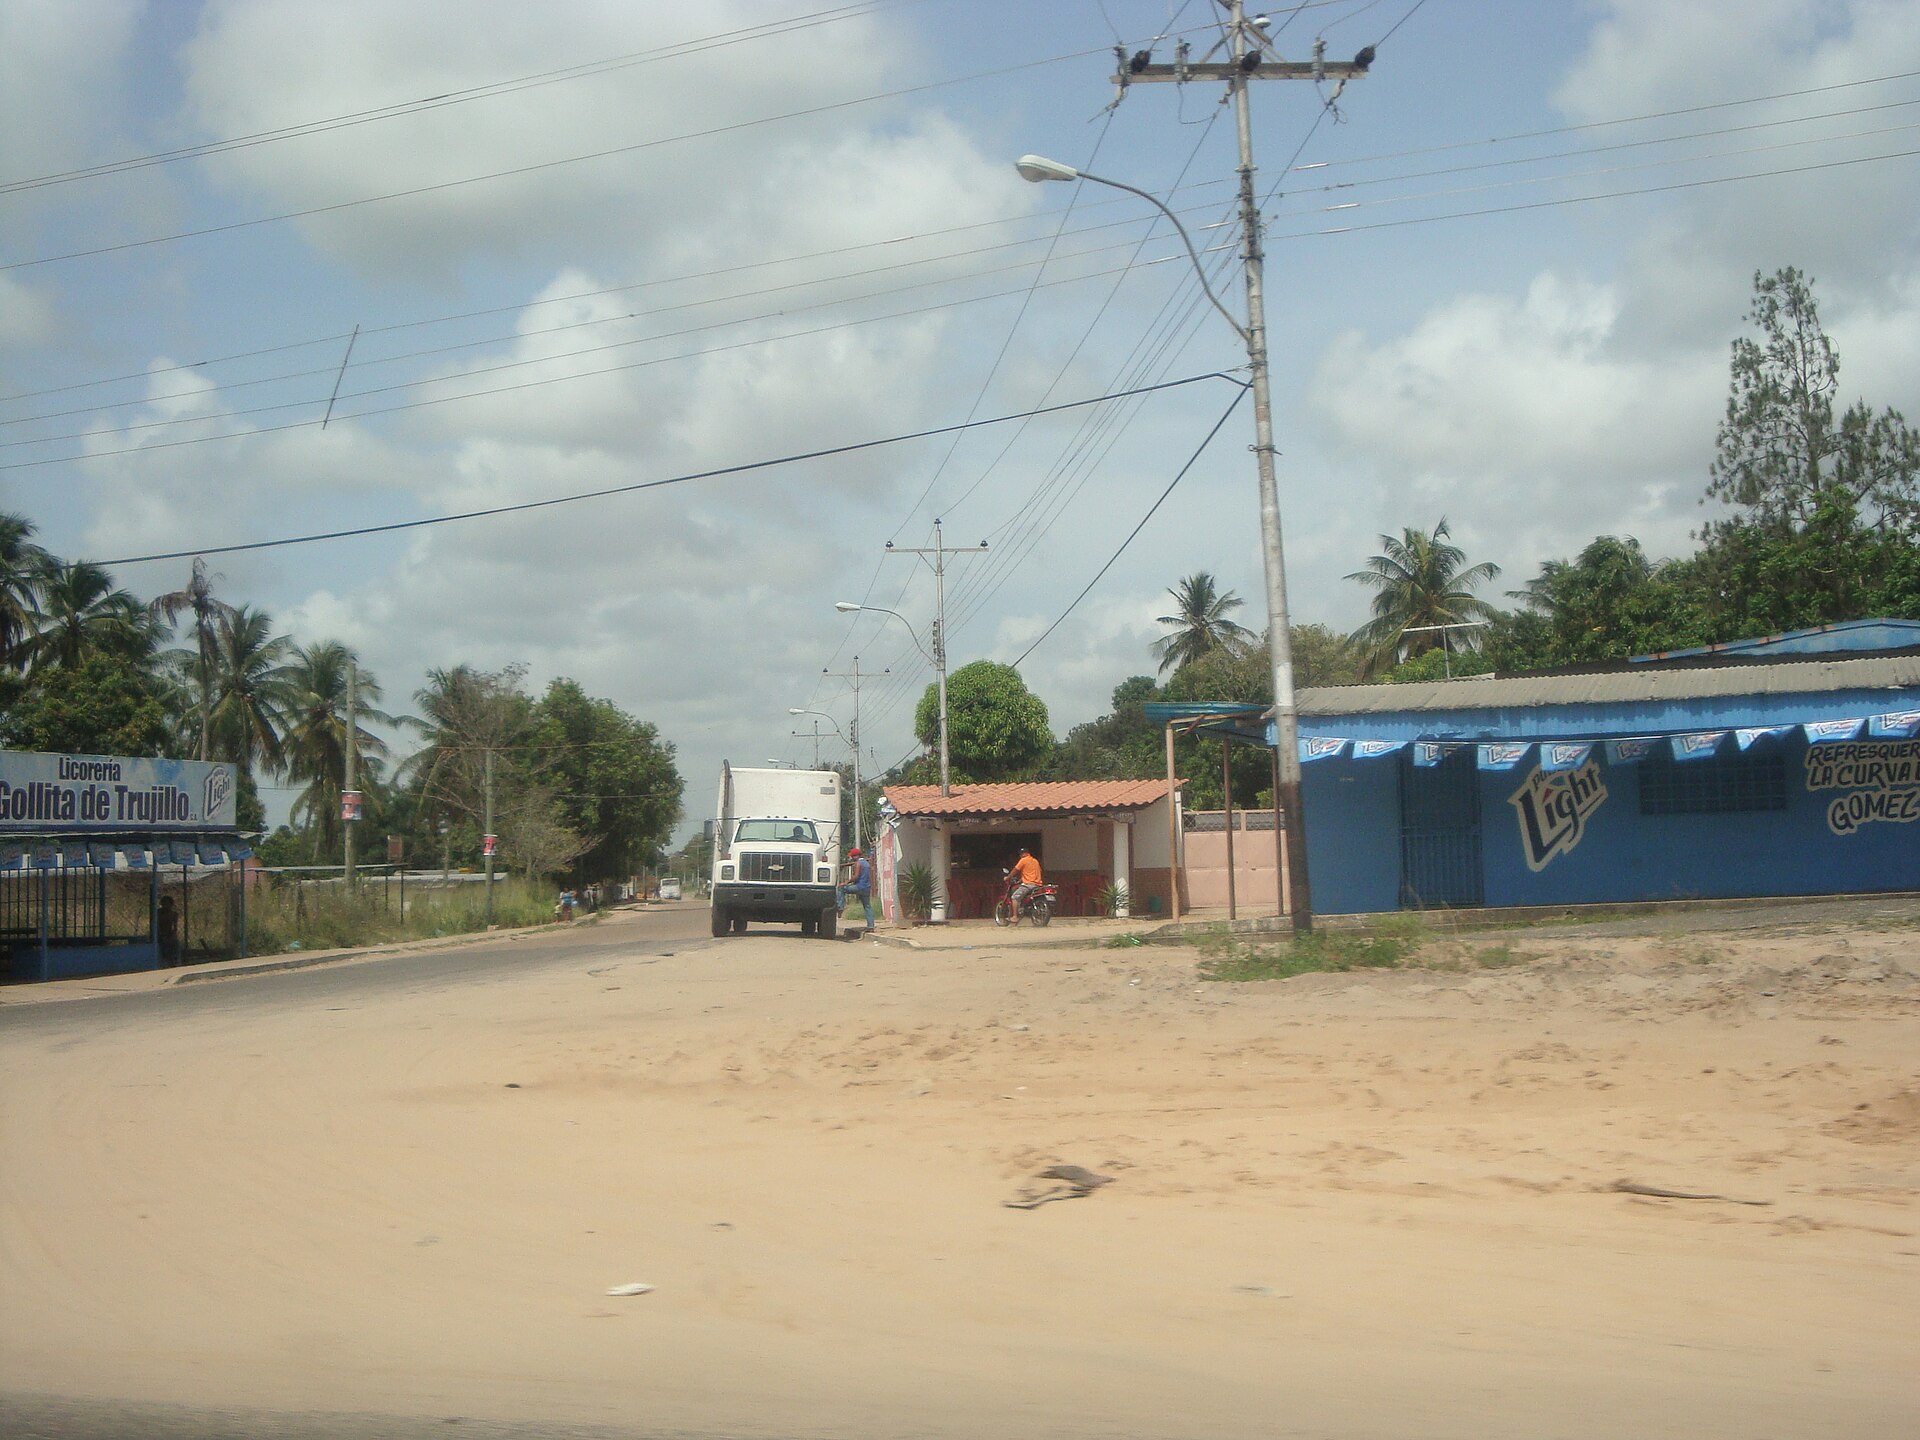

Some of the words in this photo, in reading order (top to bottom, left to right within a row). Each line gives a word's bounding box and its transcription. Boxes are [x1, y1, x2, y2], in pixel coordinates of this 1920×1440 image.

[58, 756, 121, 782] Licorería
[1809, 765, 1833, 787] LA
[1836, 761, 1911, 789] CURVA
[0, 780, 76, 821] Gollita
[80, 783, 111, 821] de
[115, 784, 190, 824] Trujillo
[1518, 767, 1598, 864] Light
[1831, 791, 1918, 831] GOMEZ
